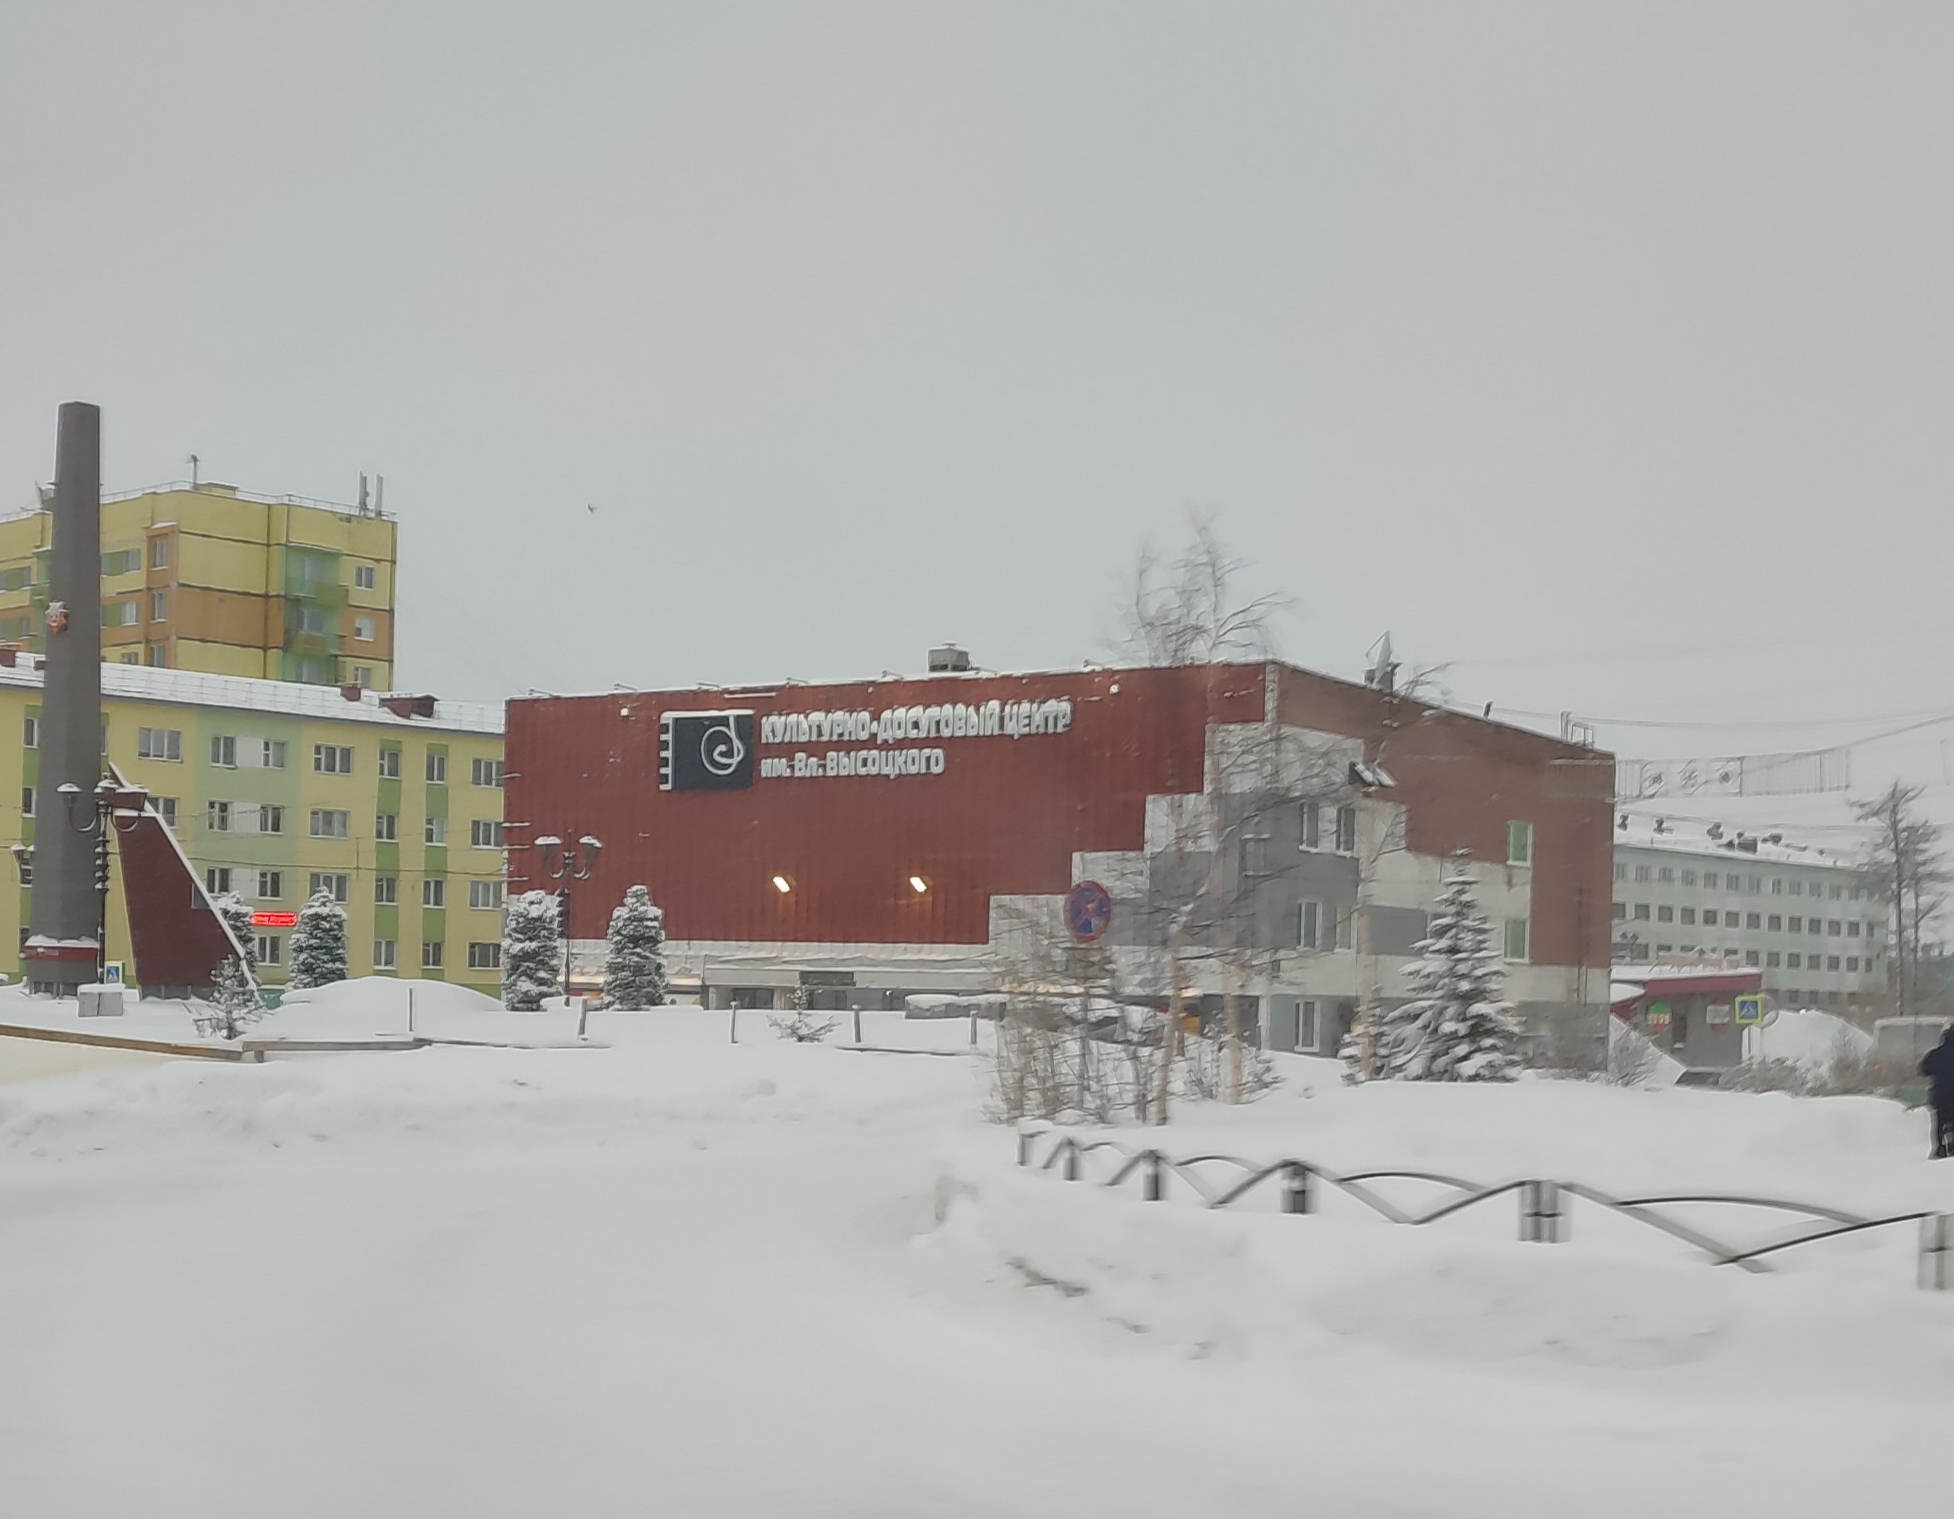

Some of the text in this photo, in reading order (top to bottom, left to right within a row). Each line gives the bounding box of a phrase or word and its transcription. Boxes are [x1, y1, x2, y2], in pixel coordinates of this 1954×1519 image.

[761, 698, 1072, 745] КУЛЬТУРНО-ДОСУГОВЫЙ ЦЕНТР
[761, 748, 945, 779] им. Вл. ВЫСОЦКОГО
